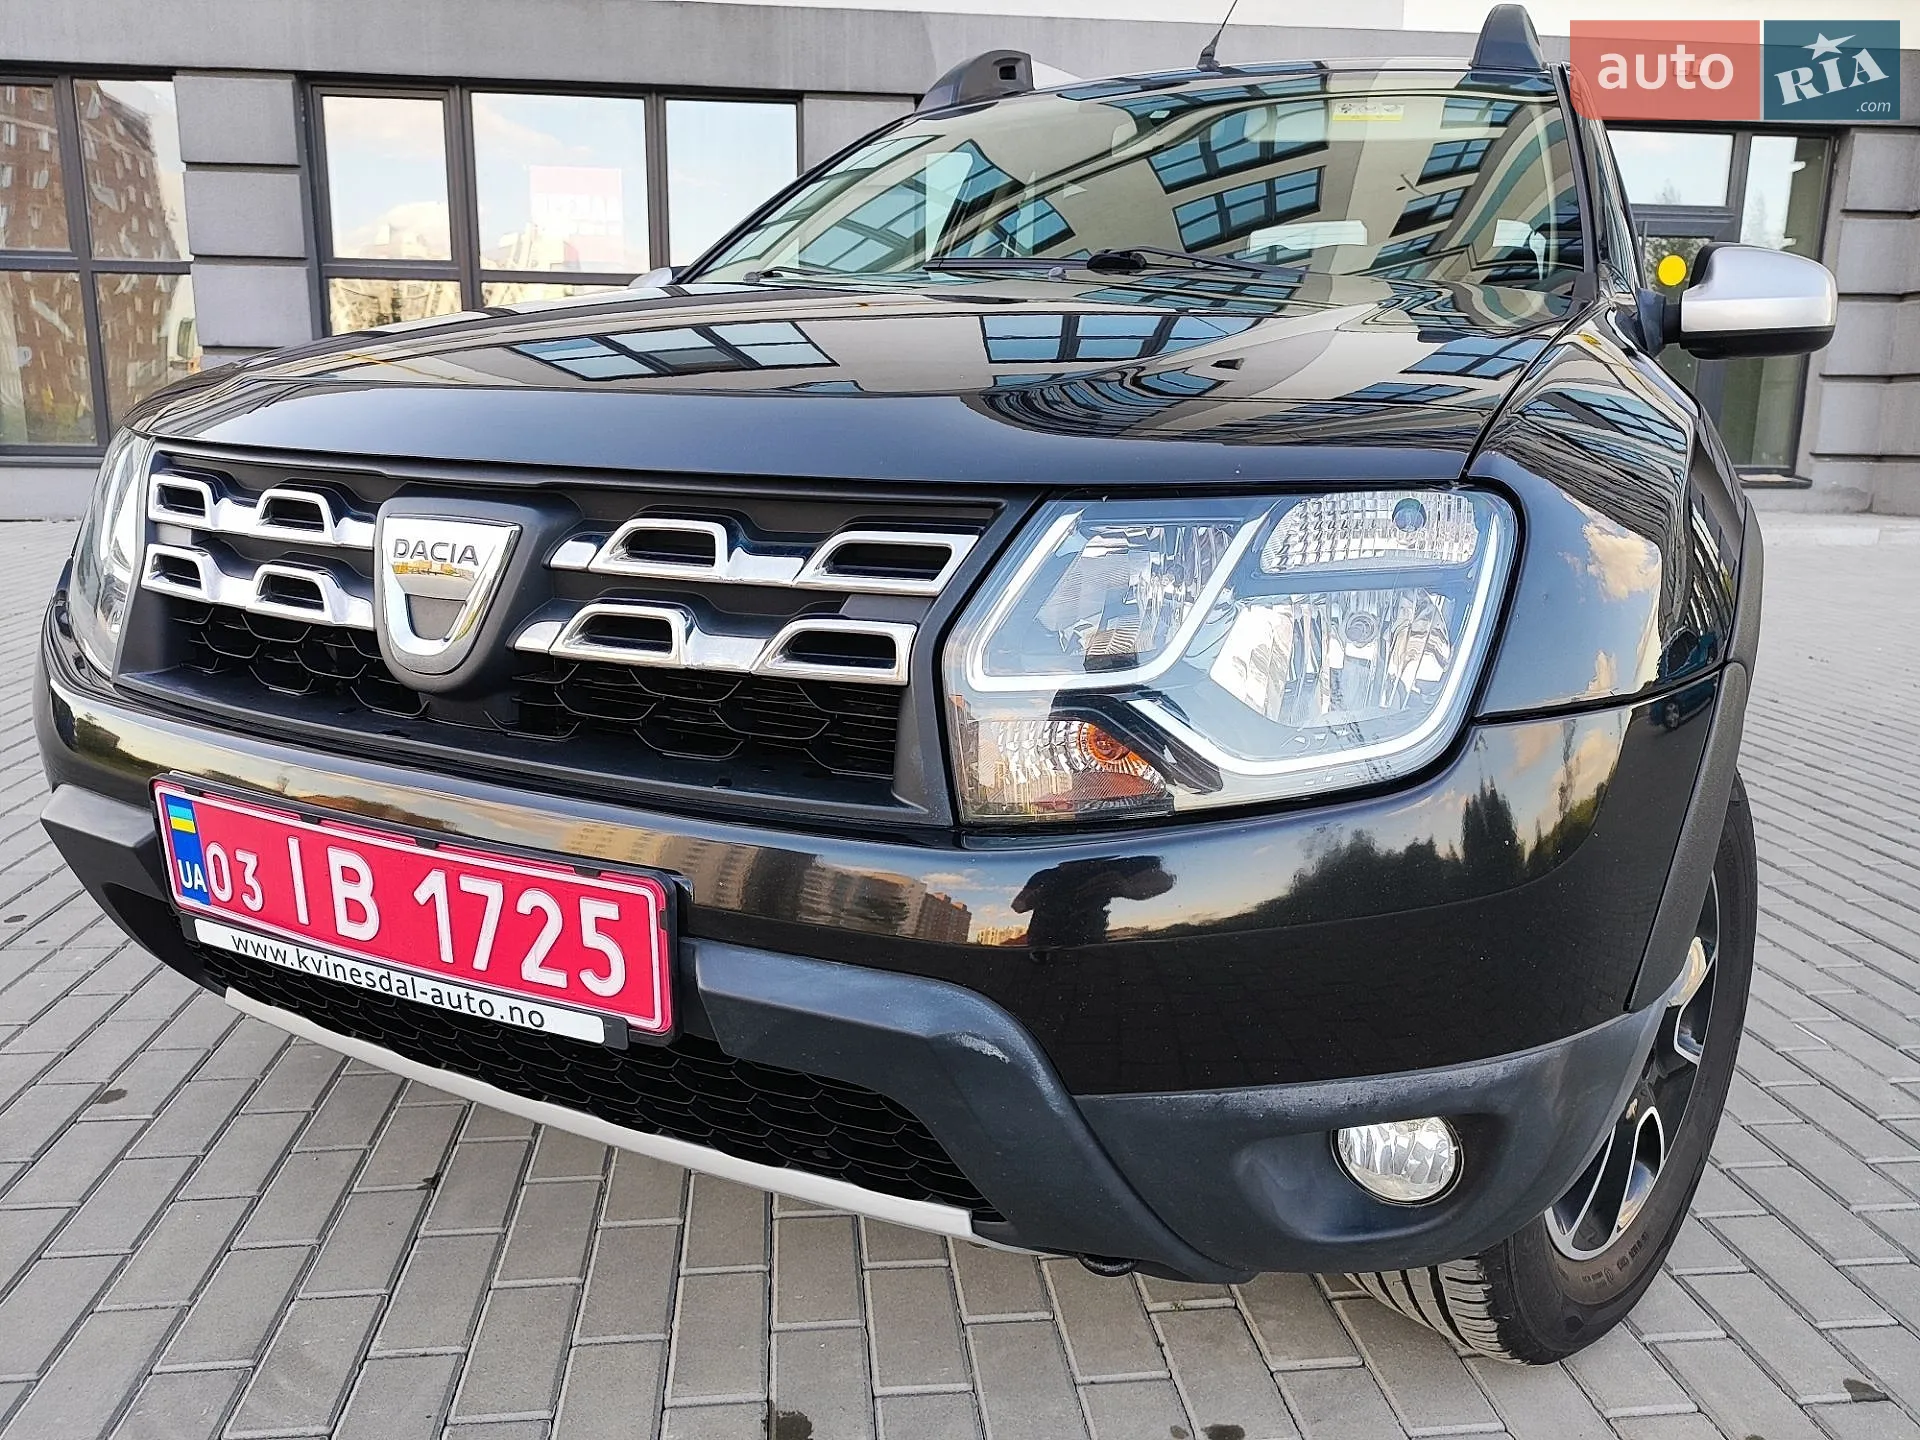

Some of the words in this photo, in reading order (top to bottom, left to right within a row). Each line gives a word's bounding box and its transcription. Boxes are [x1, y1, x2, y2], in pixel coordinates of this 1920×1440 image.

[393, 539, 479, 566] DACIA
[177, 859, 207, 892] UA
[206, 842, 264, 912] 03
[414, 868, 626, 997] 1725
[230, 933, 545, 1029] www.kvinesdal-auto.no
